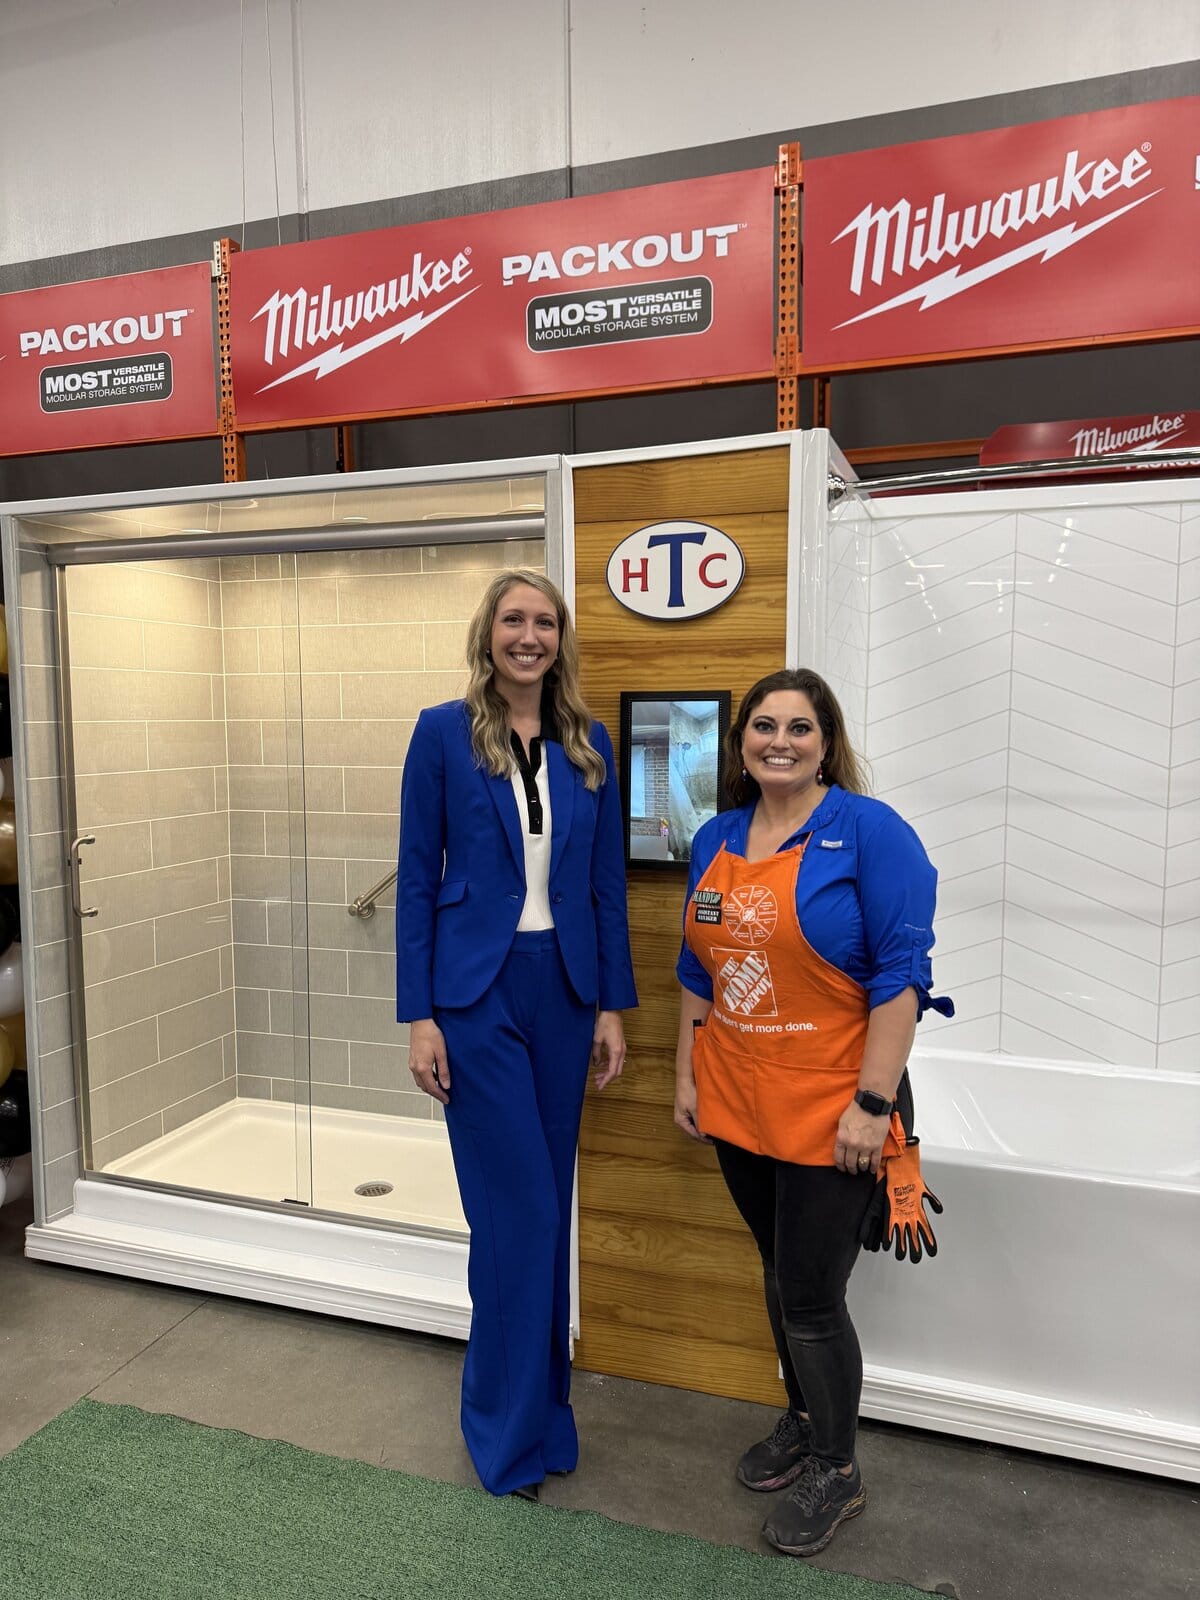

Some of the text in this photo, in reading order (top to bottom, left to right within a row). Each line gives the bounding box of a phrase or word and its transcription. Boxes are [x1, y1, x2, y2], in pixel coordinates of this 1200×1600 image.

[830, 149, 1152, 297] Milwaukee
[502, 223, 739, 287] PACKOUT
[250, 252, 473, 366] Milwaukee
[535, 288, 702, 329] MOST VERSATILE
[535, 311, 698, 341] MODULAR STORAGE SYSTEM
[628, 299, 702, 318] DURABLE
[19, 309, 189, 358] PACKOUT
[45, 362, 165, 394] MOST VERSATILE
[46, 382, 163, 403] MODULAR STORAGE SYSTEM
[113, 371, 166, 386] DURABLE
[1068, 415, 1185, 457] Milwaukee
[720, 957, 739, 980] THE
[723, 951, 768, 1011] HOME
[741, 975, 771, 1015] DEPOT
[739, 1023, 754, 1033] get
[755, 1024, 783, 1033] more
[785, 1022, 816, 1031] done.
